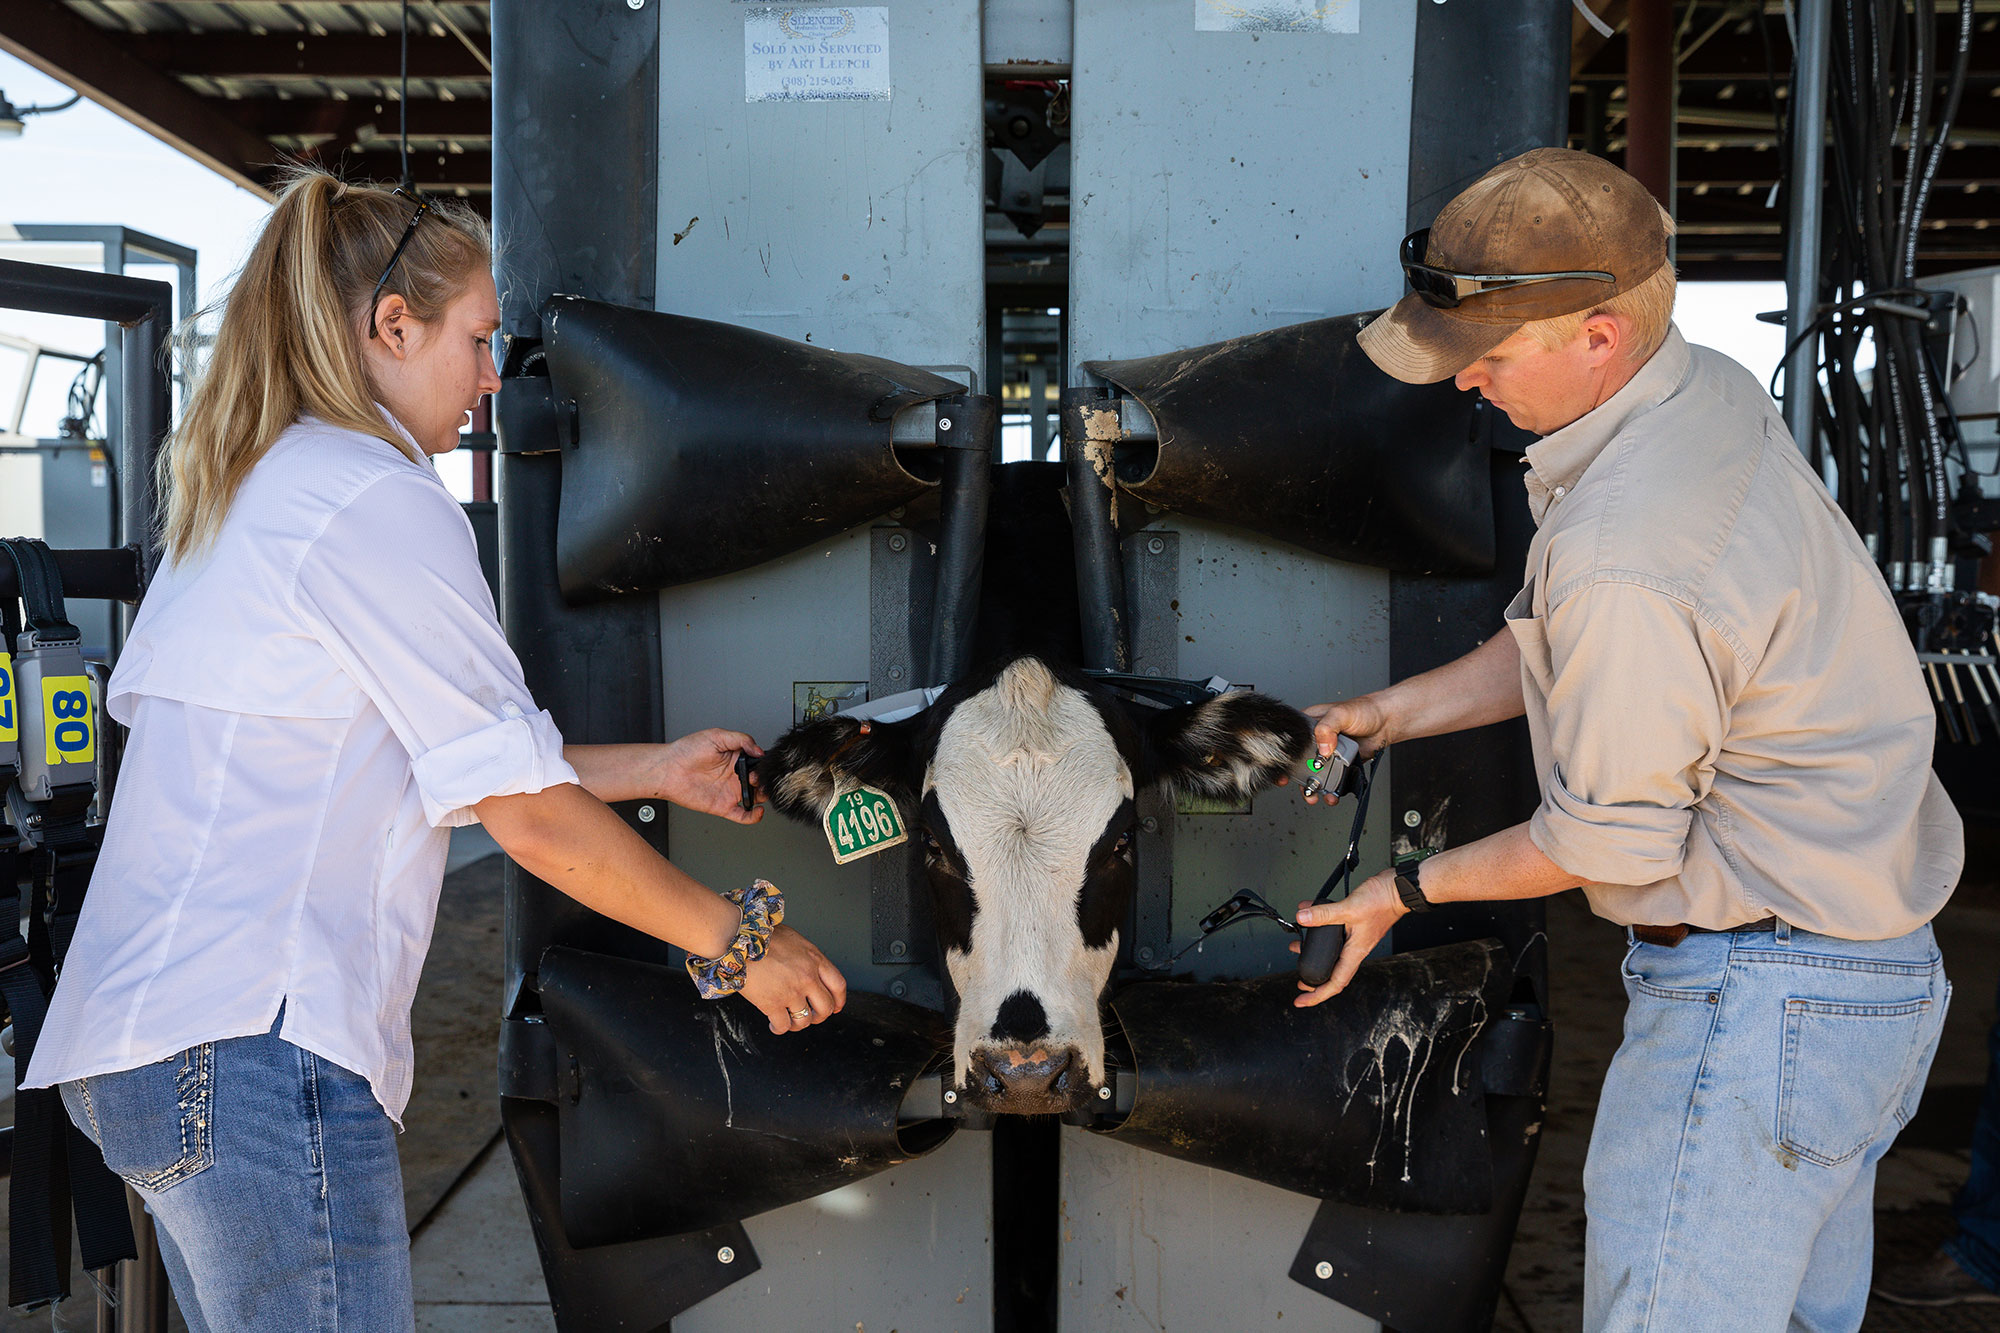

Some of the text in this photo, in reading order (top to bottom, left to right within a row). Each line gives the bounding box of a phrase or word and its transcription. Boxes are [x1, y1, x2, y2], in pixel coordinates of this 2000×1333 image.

[790, 16, 844, 25] SILENCER
[846, 792, 863, 808] 19
[838, 801, 894, 850] 4196
